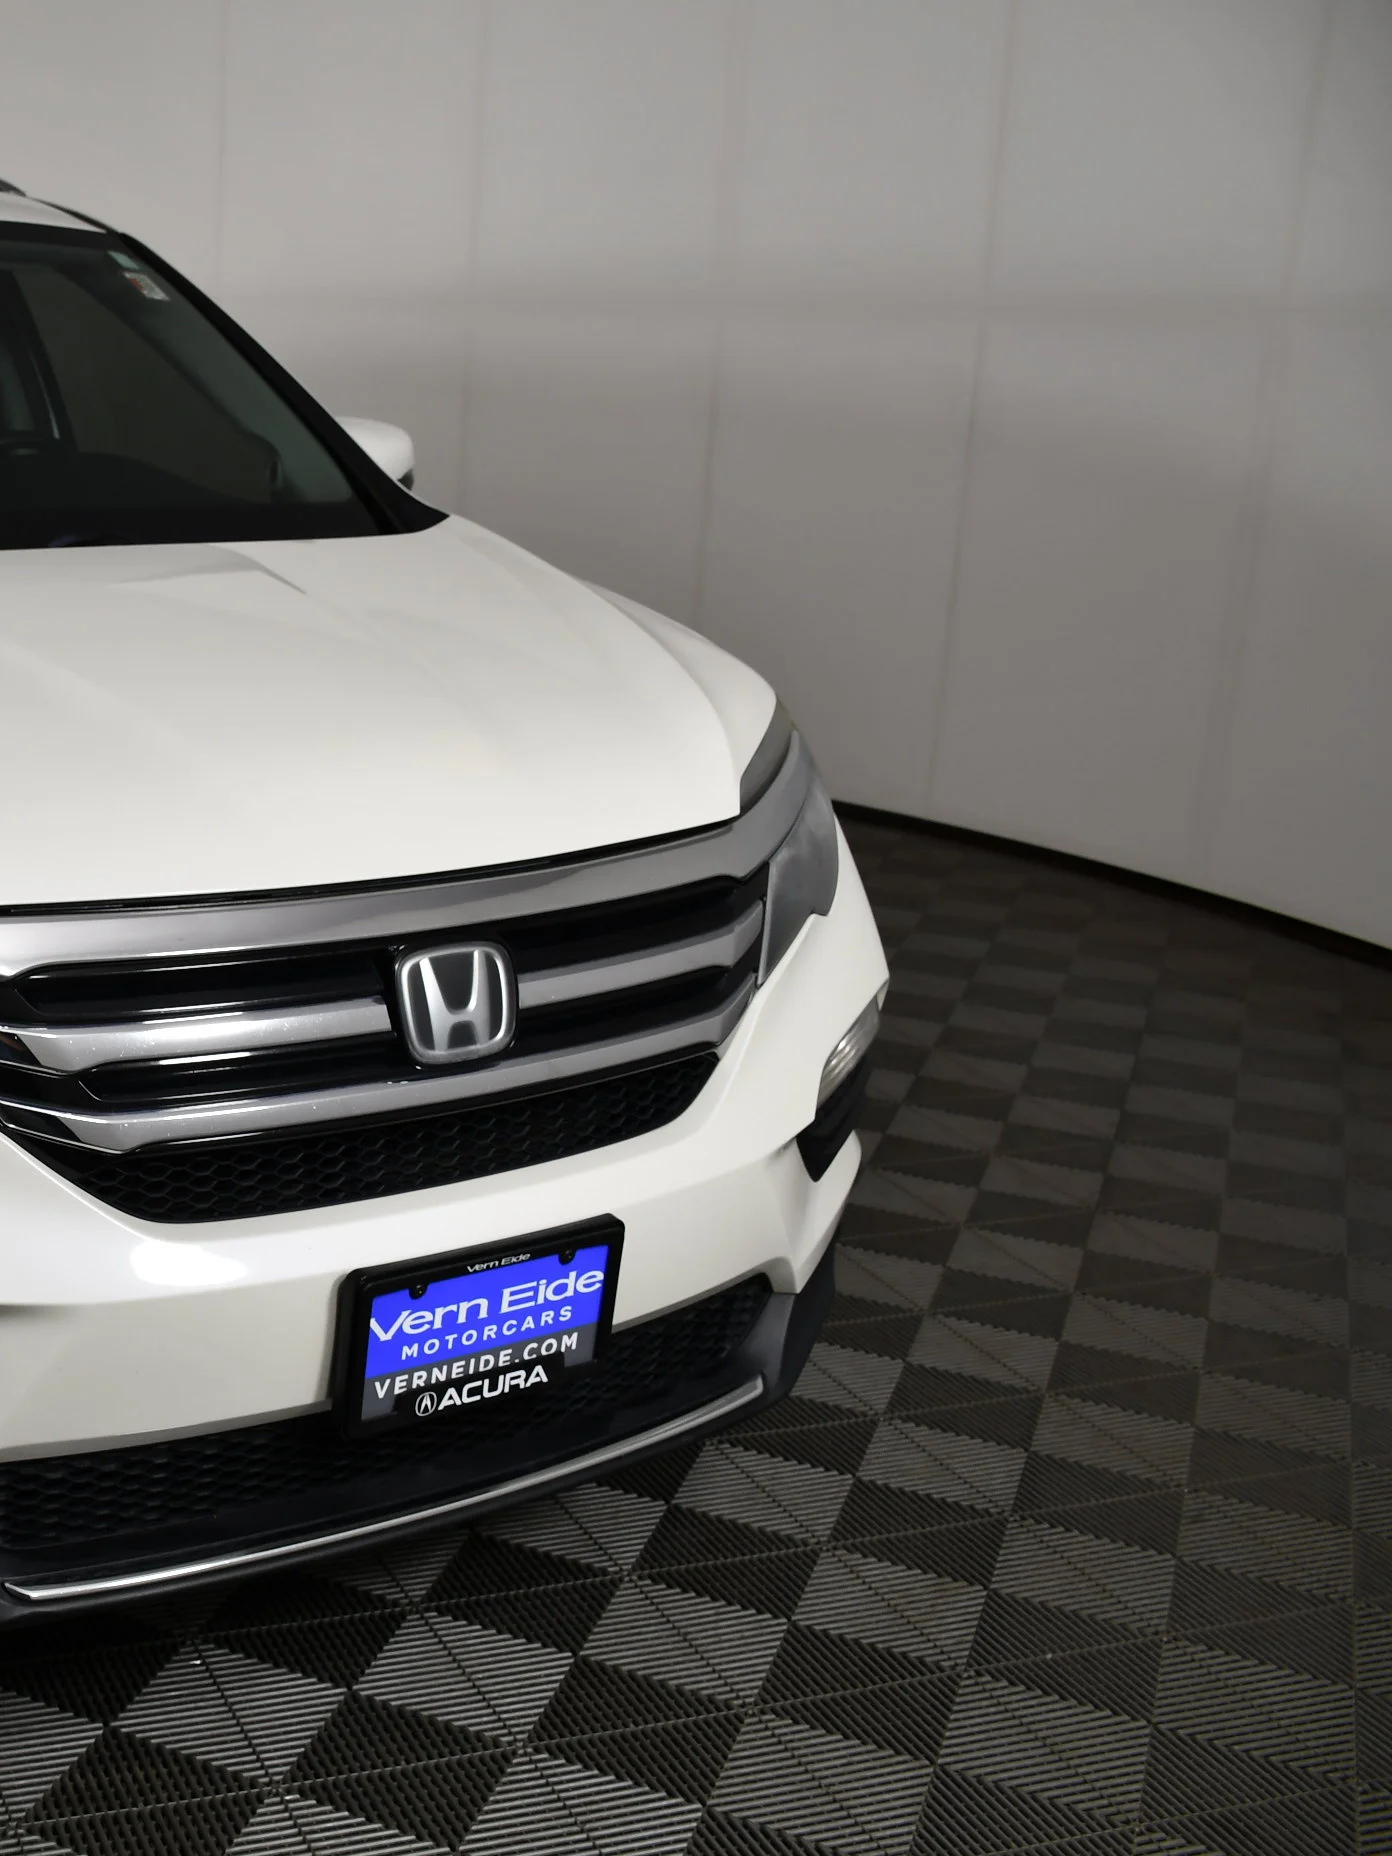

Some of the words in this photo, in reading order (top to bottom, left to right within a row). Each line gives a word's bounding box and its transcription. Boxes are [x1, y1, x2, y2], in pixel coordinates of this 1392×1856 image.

[466, 1259, 499, 1273] Vern
[500, 1252, 531, 1265] Eide
[369, 1296, 489, 1342] Vern
[499, 1269, 605, 1314] Eide
[401, 1305, 573, 1360] MOTORCARS
[374, 1332, 579, 1399] VERNEIDE.COM
[437, 1365, 549, 1411] ACURA
